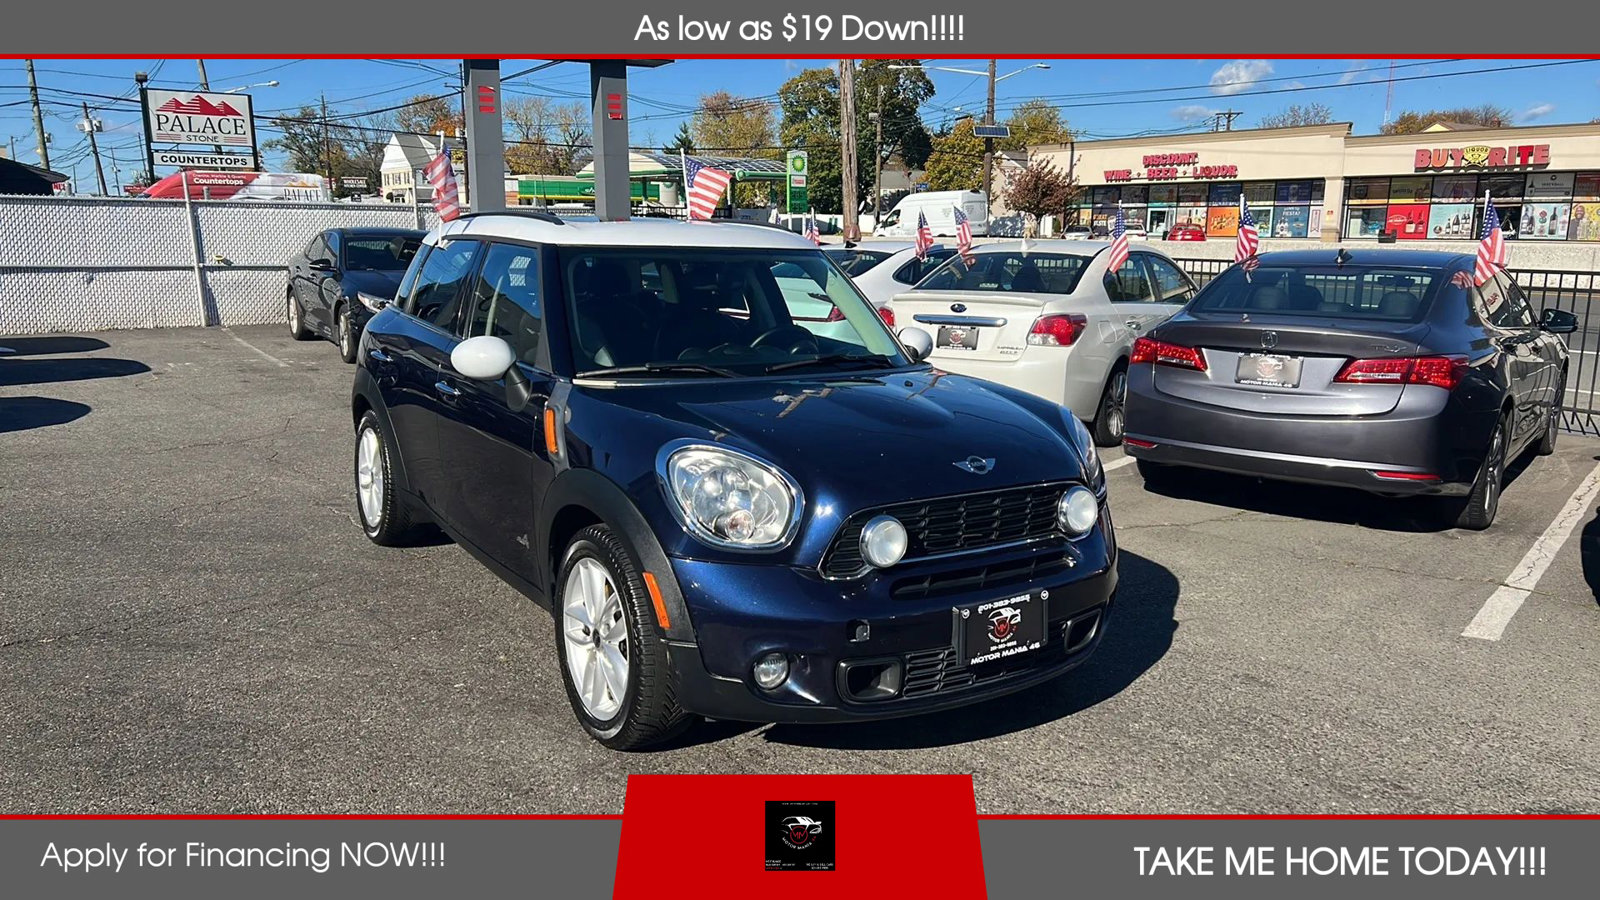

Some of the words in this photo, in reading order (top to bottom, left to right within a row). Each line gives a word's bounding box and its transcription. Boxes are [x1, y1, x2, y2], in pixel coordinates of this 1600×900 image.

[156, 114, 246, 135] PALACE
[186, 135, 219, 143] STONE
[160, 155, 248, 166] COUNTERTOPS
[1143, 153, 1198, 167] DISCOUNT
[1415, 148, 1464, 168] BUY
[1488, 145, 1550, 167] RITE
[1104, 169, 1132, 182] WINE
[1147, 168, 1178, 180] BEER
[1193, 165, 1238, 179] LIQUOR
[971, 652, 1000, 665] MOTOR
[1002, 645, 1028, 658] MANIA
[1029, 642, 1040, 650] 46
